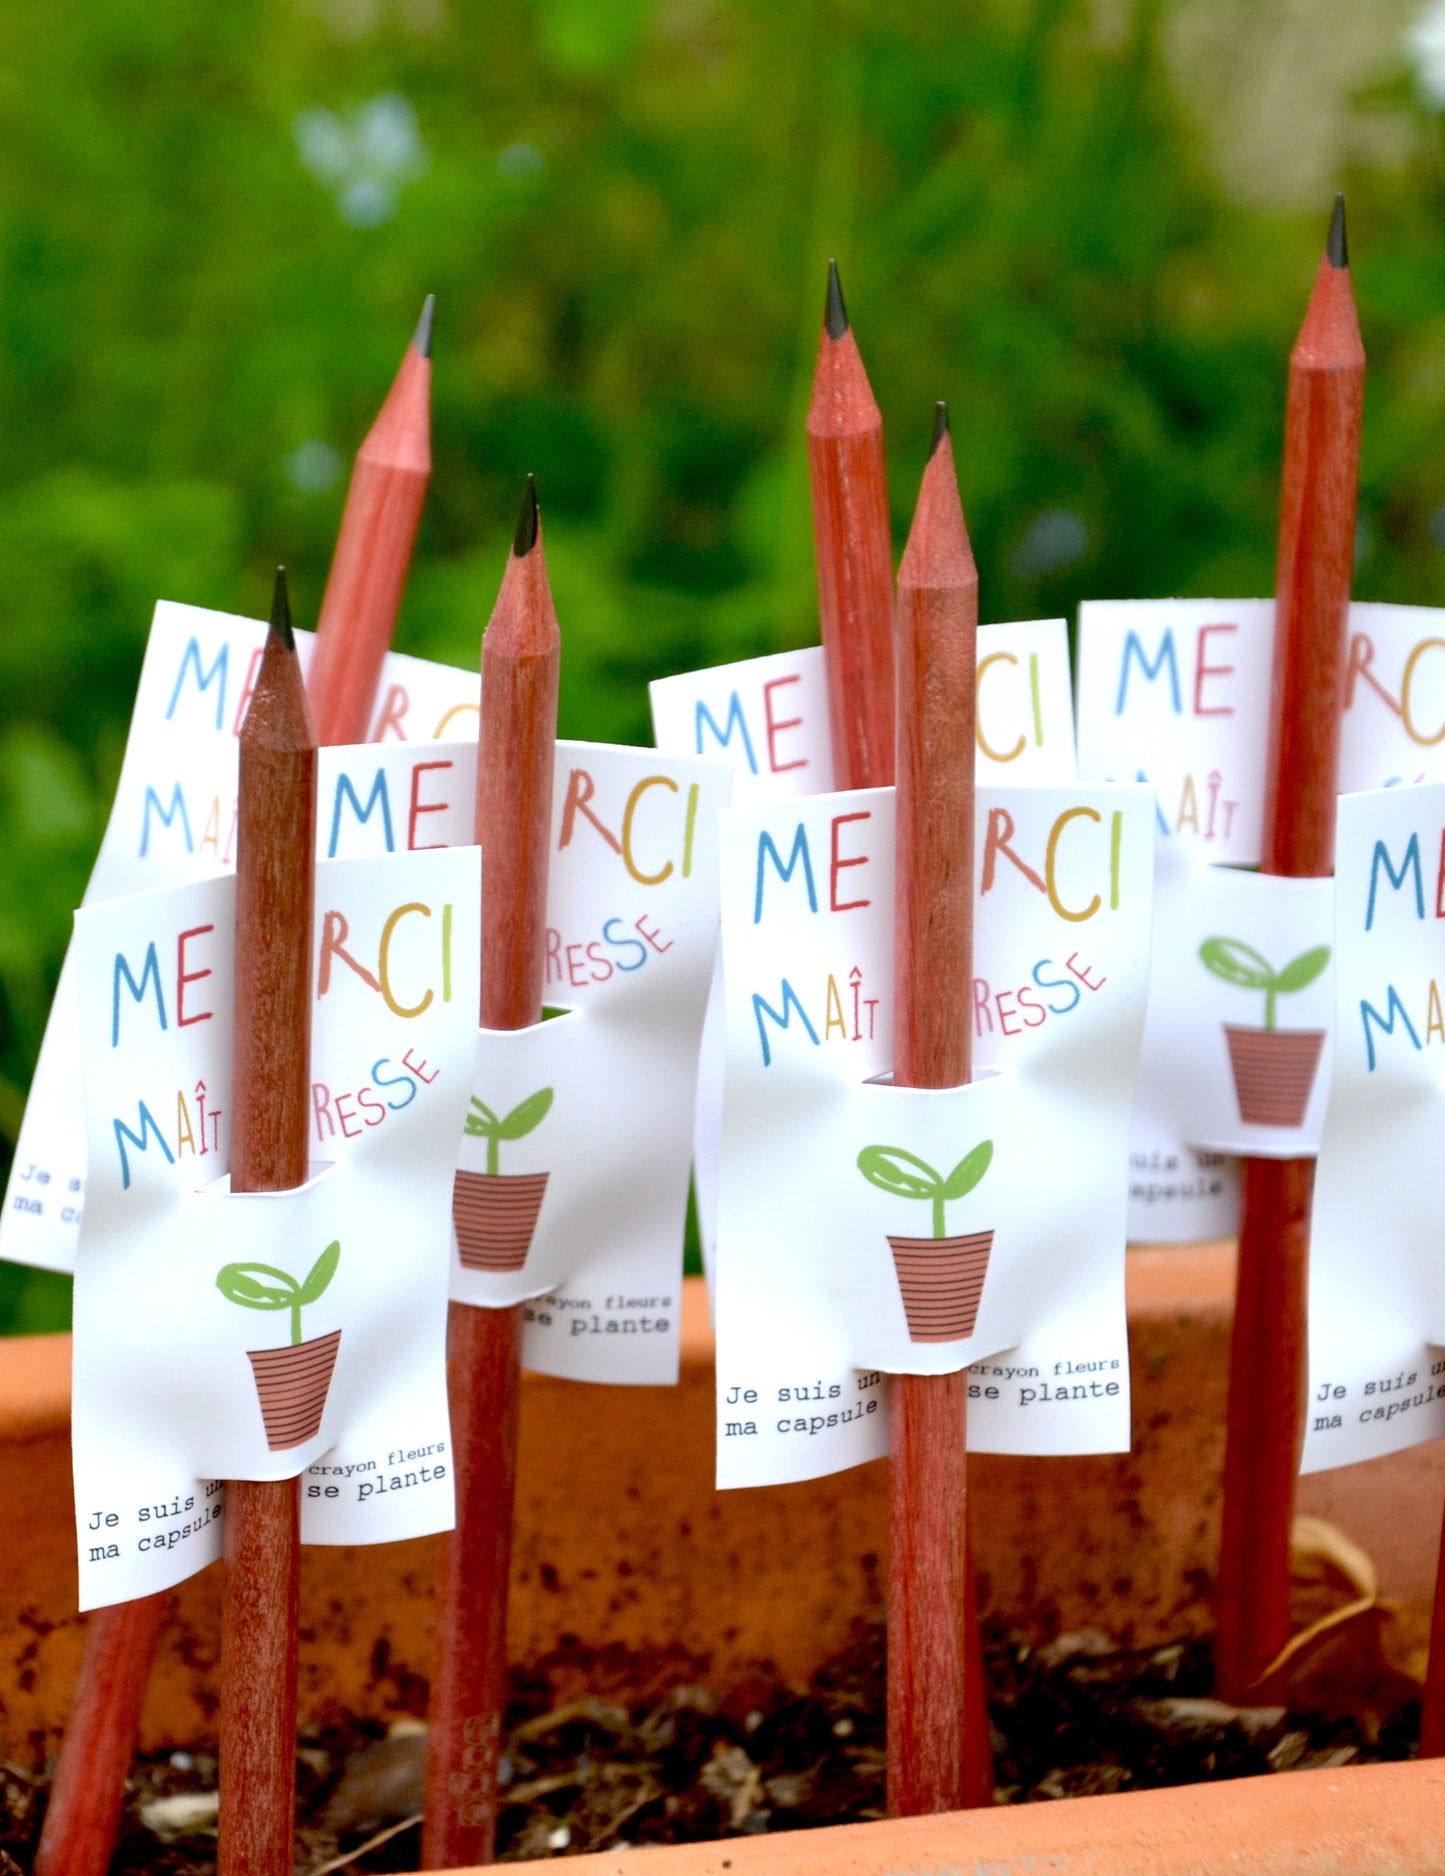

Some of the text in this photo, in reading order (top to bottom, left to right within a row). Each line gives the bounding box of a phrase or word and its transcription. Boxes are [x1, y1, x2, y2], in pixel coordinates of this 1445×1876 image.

[695, 652, 1043, 775] MECI
[328, 760, 700, 886] MERCI
[756, 806, 1124, 924] MERCI
[112, 902, 454, 1048] MERCI
[569, 1315, 670, 1336] plante
[604, 1295, 672, 1309] fleurs
[725, 1380, 1120, 1437] ma capsule se plante
[726, 1358, 1120, 1404] Je suis un crayon fleurs
[1317, 1383, 1347, 1401] Je
[1363, 1371, 1418, 1396] suis
[1313, 1414, 1343, 1432] ma
[89, 1511, 119, 1531] Je
[138, 1495, 195, 1522] suis
[308, 1460, 376, 1478] crayon
[387, 1442, 445, 1466] fleurs
[89, 1464, 446, 1562] ma capsule se plante
